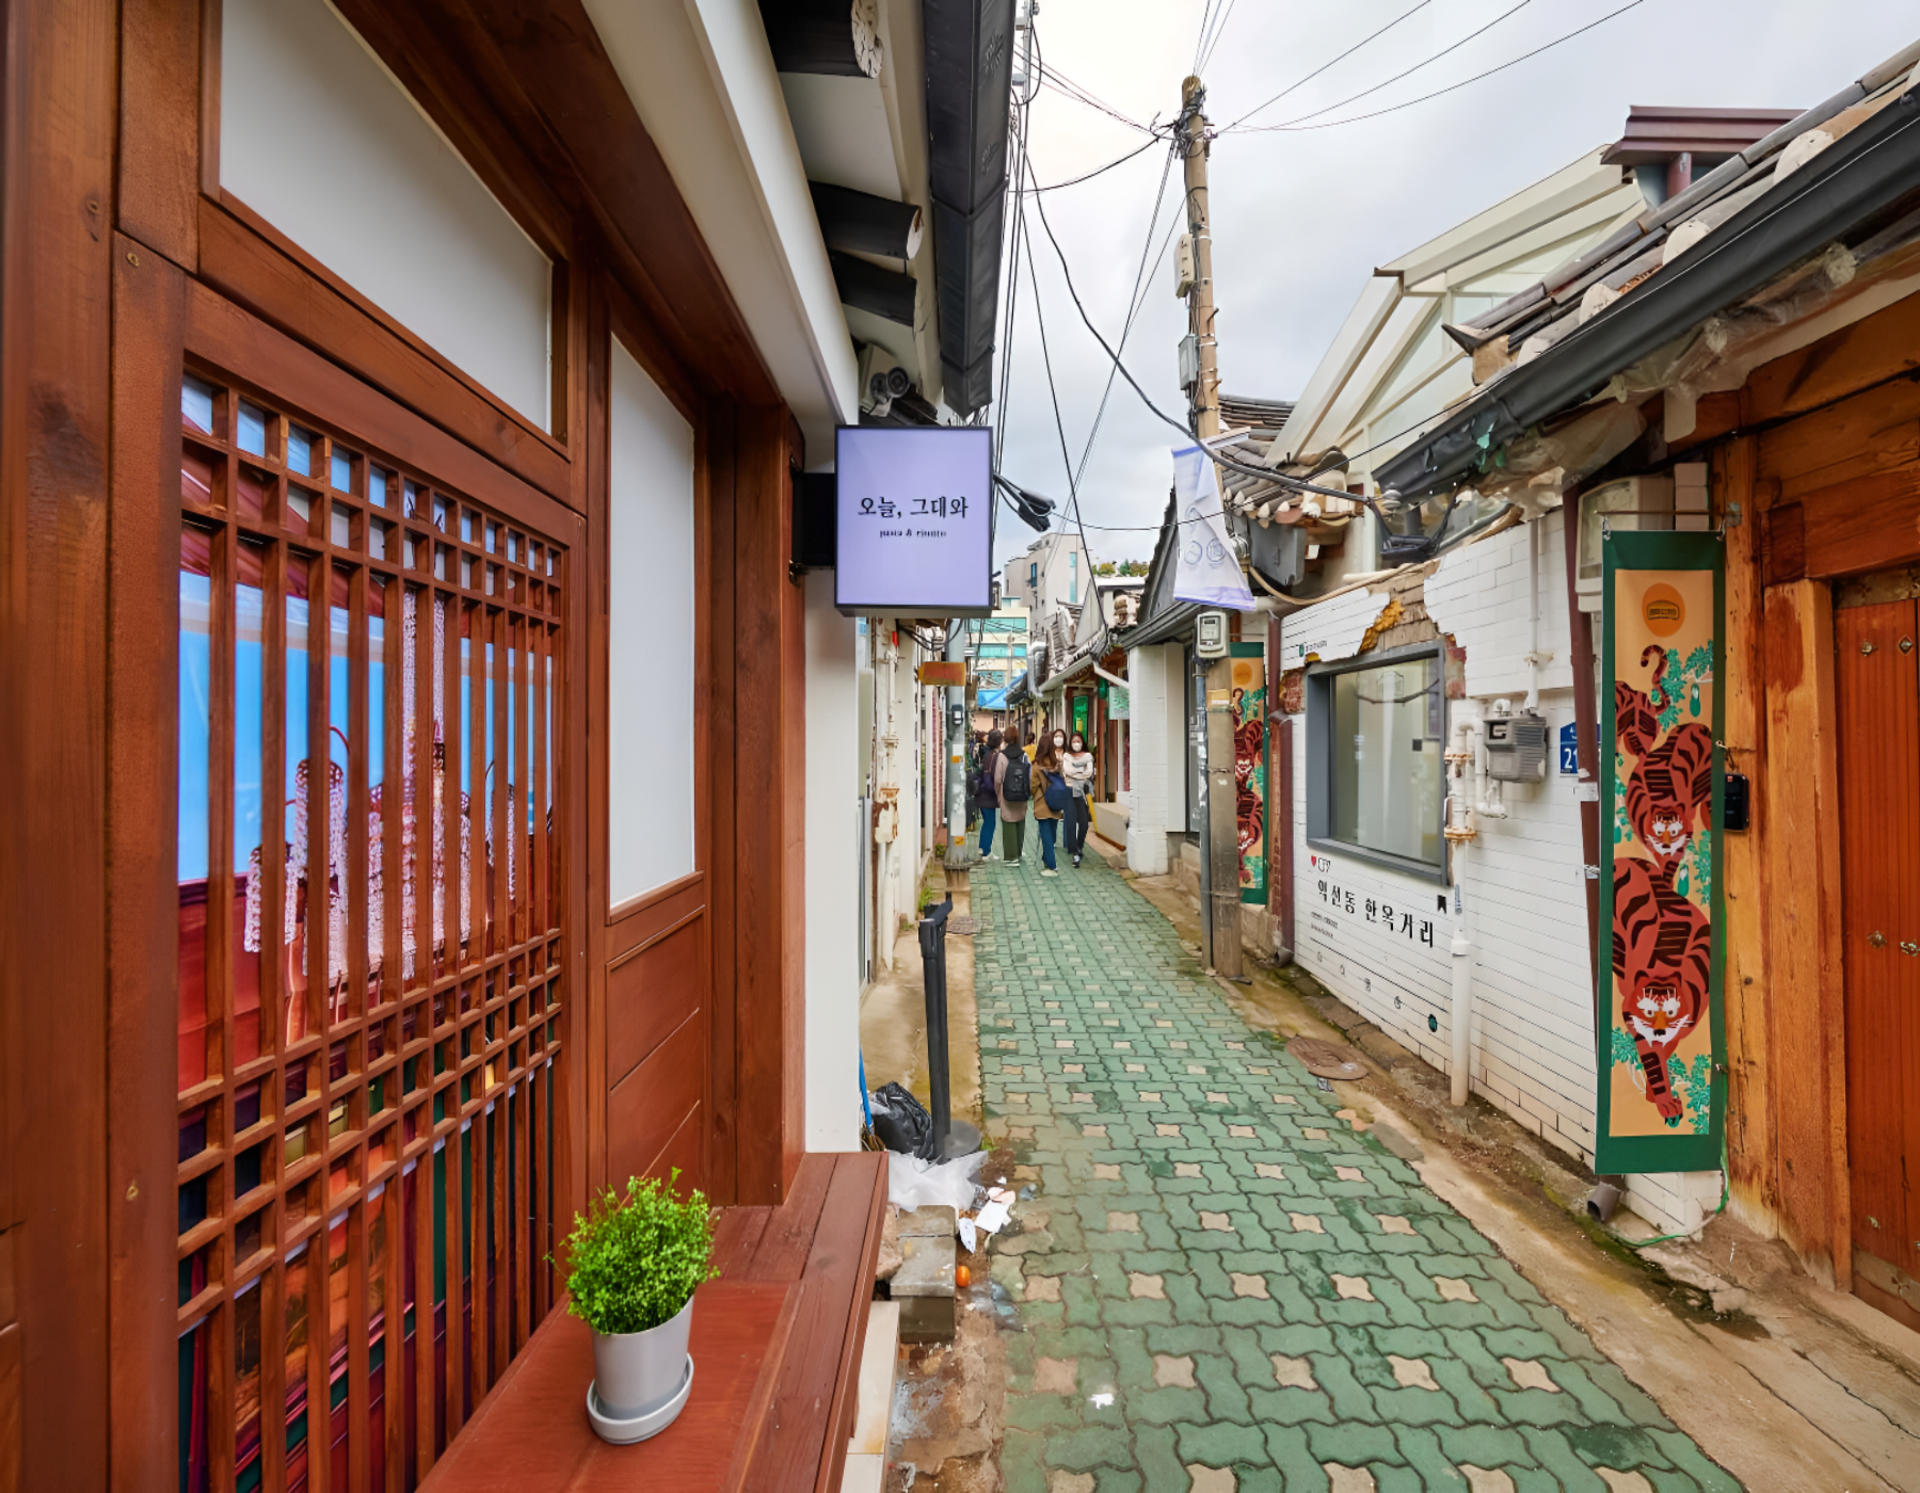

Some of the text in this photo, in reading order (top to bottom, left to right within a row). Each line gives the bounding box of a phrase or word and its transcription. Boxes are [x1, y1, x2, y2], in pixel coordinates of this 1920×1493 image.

[857, 496, 969, 519] 오늘, 그대와
[1318, 880, 1356, 914] 익선동
[1365, 898, 1434, 949] 한옥거리
